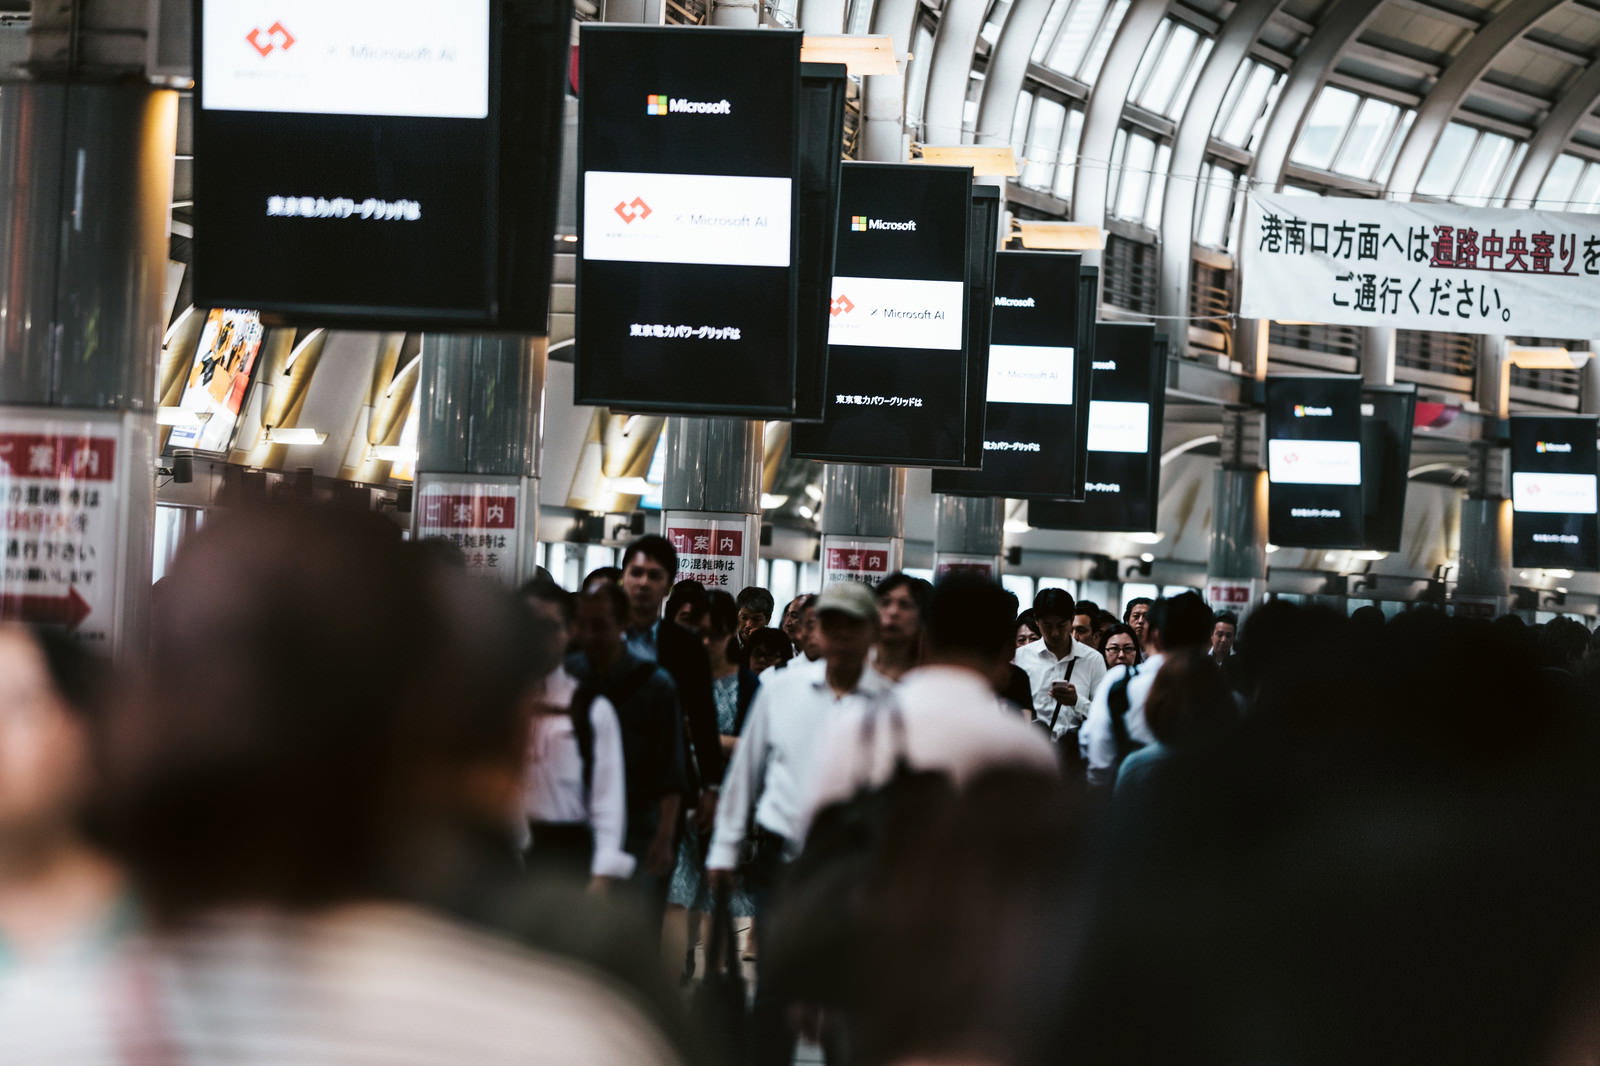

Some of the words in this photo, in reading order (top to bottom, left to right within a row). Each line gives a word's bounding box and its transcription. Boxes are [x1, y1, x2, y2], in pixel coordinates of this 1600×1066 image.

[669, 98, 731, 114] Microsoft
[690, 213, 751, 227] Microsoft
[868, 219, 917, 231] Microsoft
[995, 296, 1036, 308] Microsoft
[1332, 271, 1511, 322] ご通行ください。
[884, 308, 932, 320] Microsoft
[934, 310, 945, 320] AI
[426, 503, 504, 524] ご案内
[674, 534, 734, 552] ご案内
